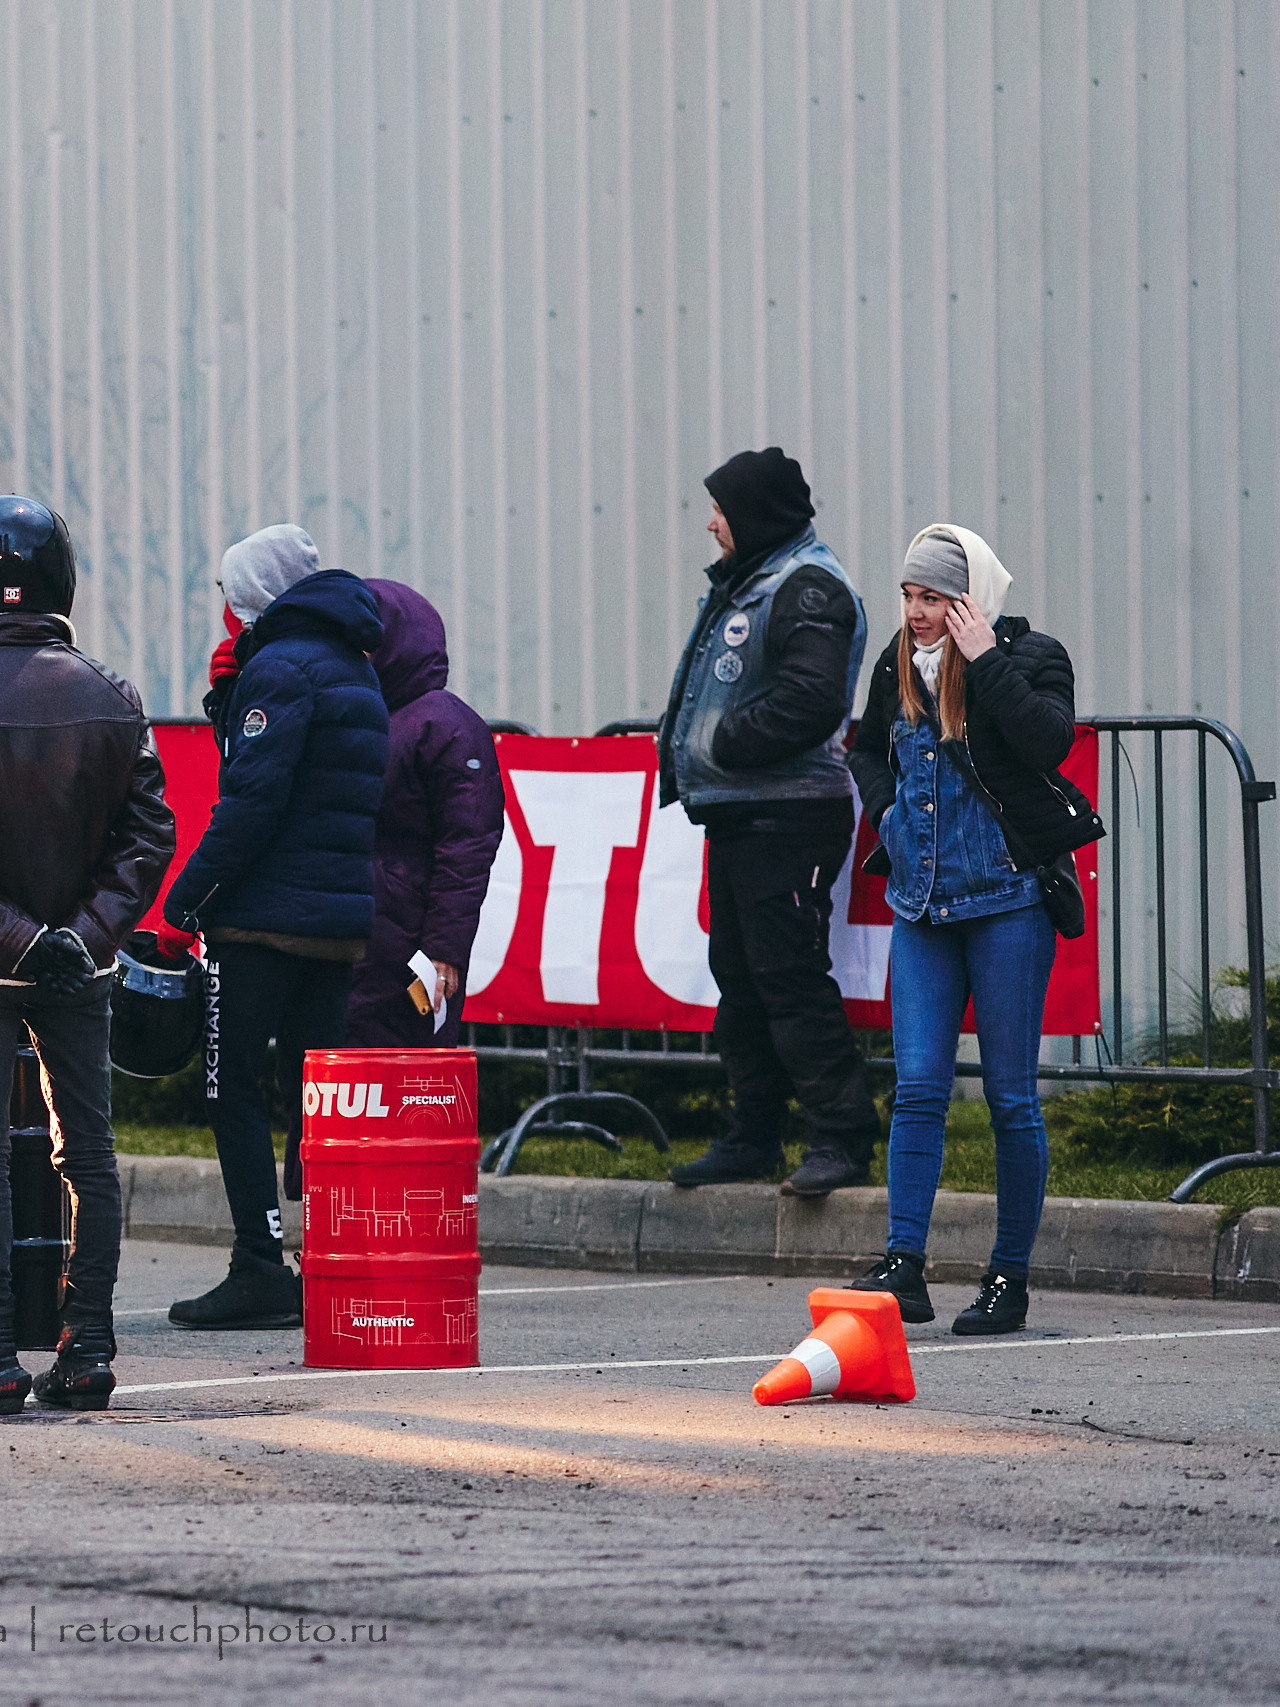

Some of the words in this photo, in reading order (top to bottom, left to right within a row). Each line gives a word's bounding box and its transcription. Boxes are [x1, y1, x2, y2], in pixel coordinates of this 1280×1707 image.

[205, 961, 221, 1099] EXCHANGE
[303, 1081, 390, 1118] OTUL
[402, 1095, 456, 1105] SPECIALIST
[352, 1317, 415, 1327] AUTHENTIC
